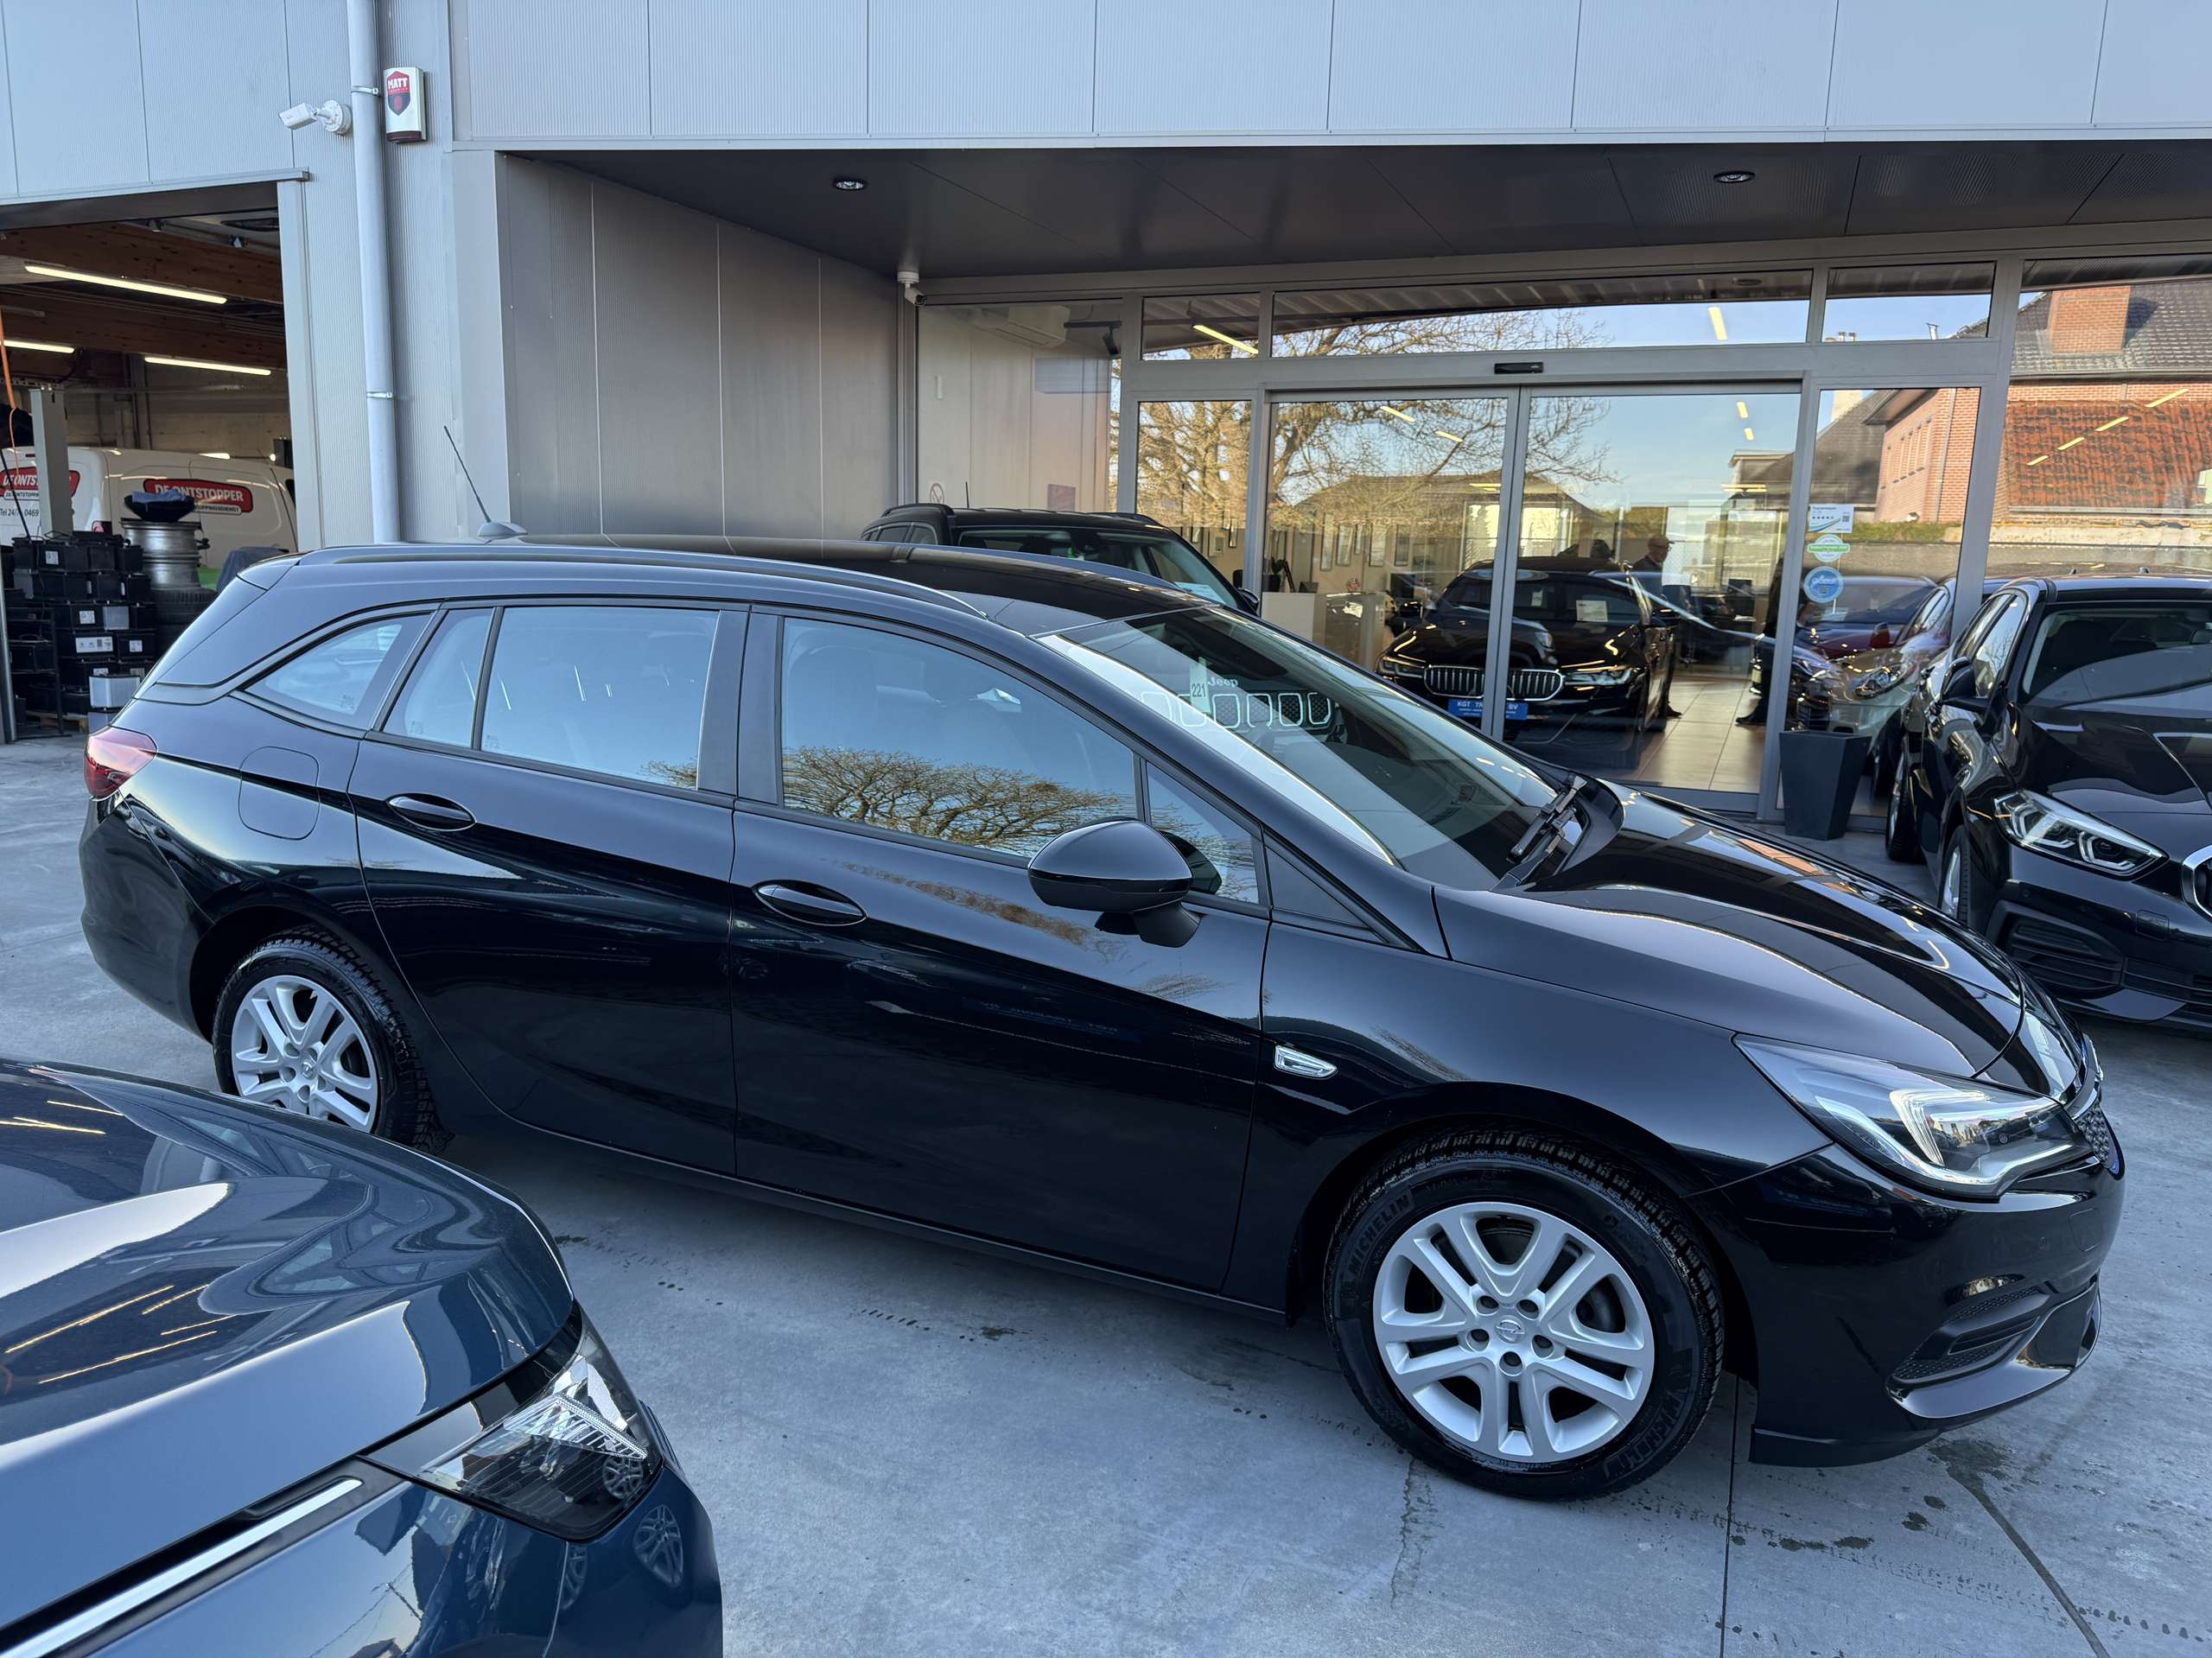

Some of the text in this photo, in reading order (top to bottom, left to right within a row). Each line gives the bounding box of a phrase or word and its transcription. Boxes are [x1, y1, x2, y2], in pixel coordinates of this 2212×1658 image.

[387, 77, 408, 90] MATT
[1207, 677, 1238, 688] Jeep
[1192, 683, 1206, 698] 221
[1346, 1193, 1411, 1275] MICHELIN
